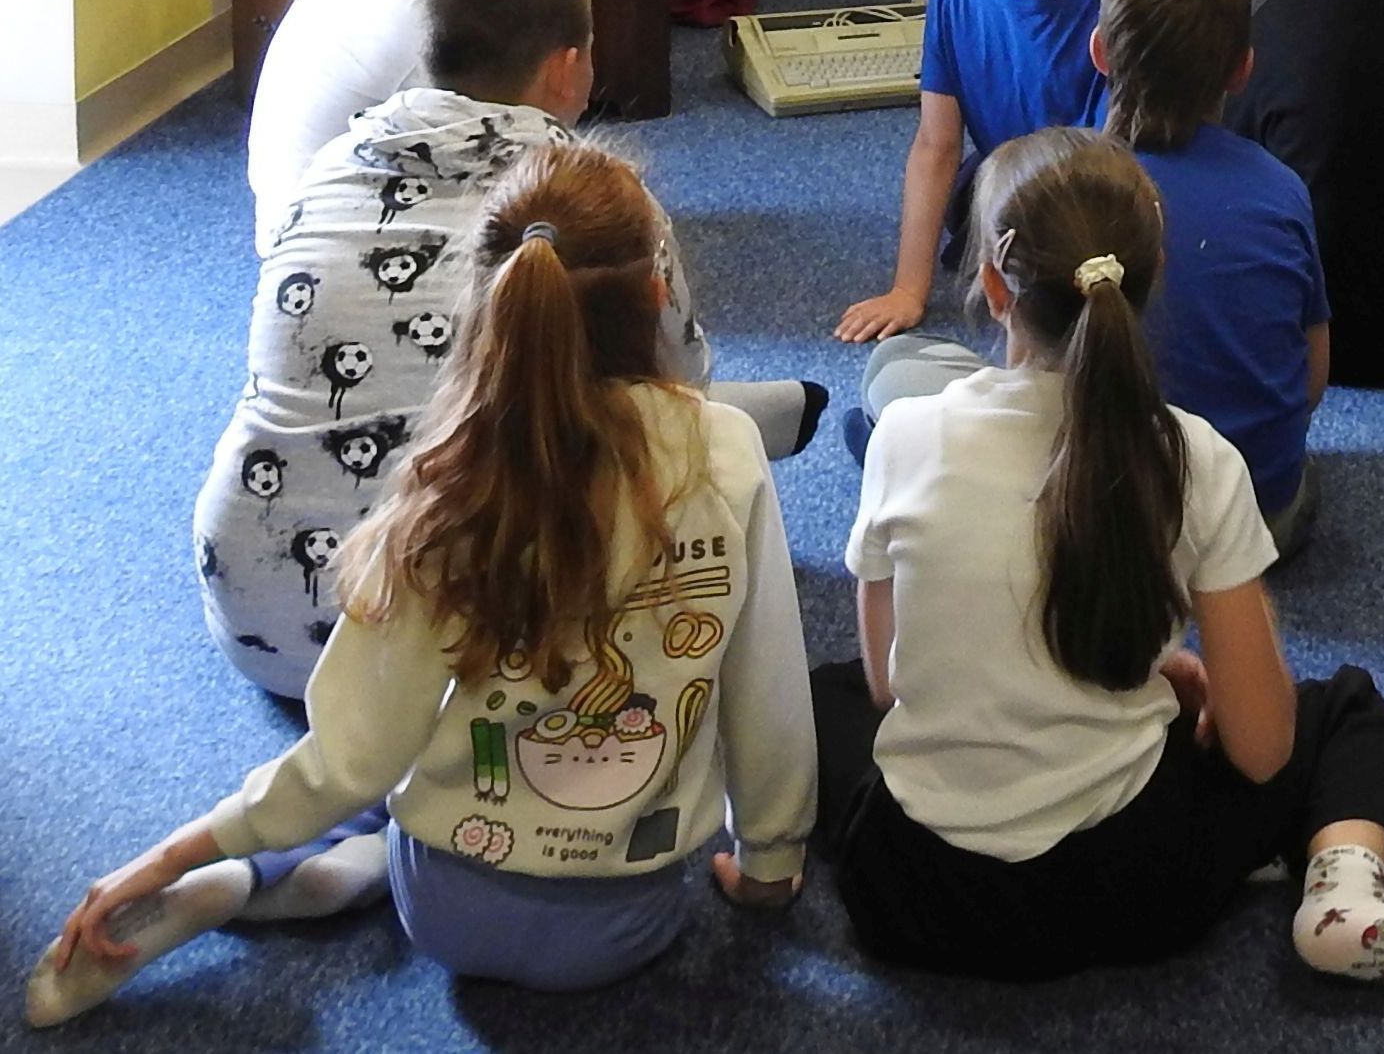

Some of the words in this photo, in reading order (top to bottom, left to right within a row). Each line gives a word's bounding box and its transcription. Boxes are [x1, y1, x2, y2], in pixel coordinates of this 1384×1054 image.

[653, 535, 727, 566] USE
[535, 825, 614, 846] everything
[542, 844, 555, 858] is
[560, 847, 599, 862] good
